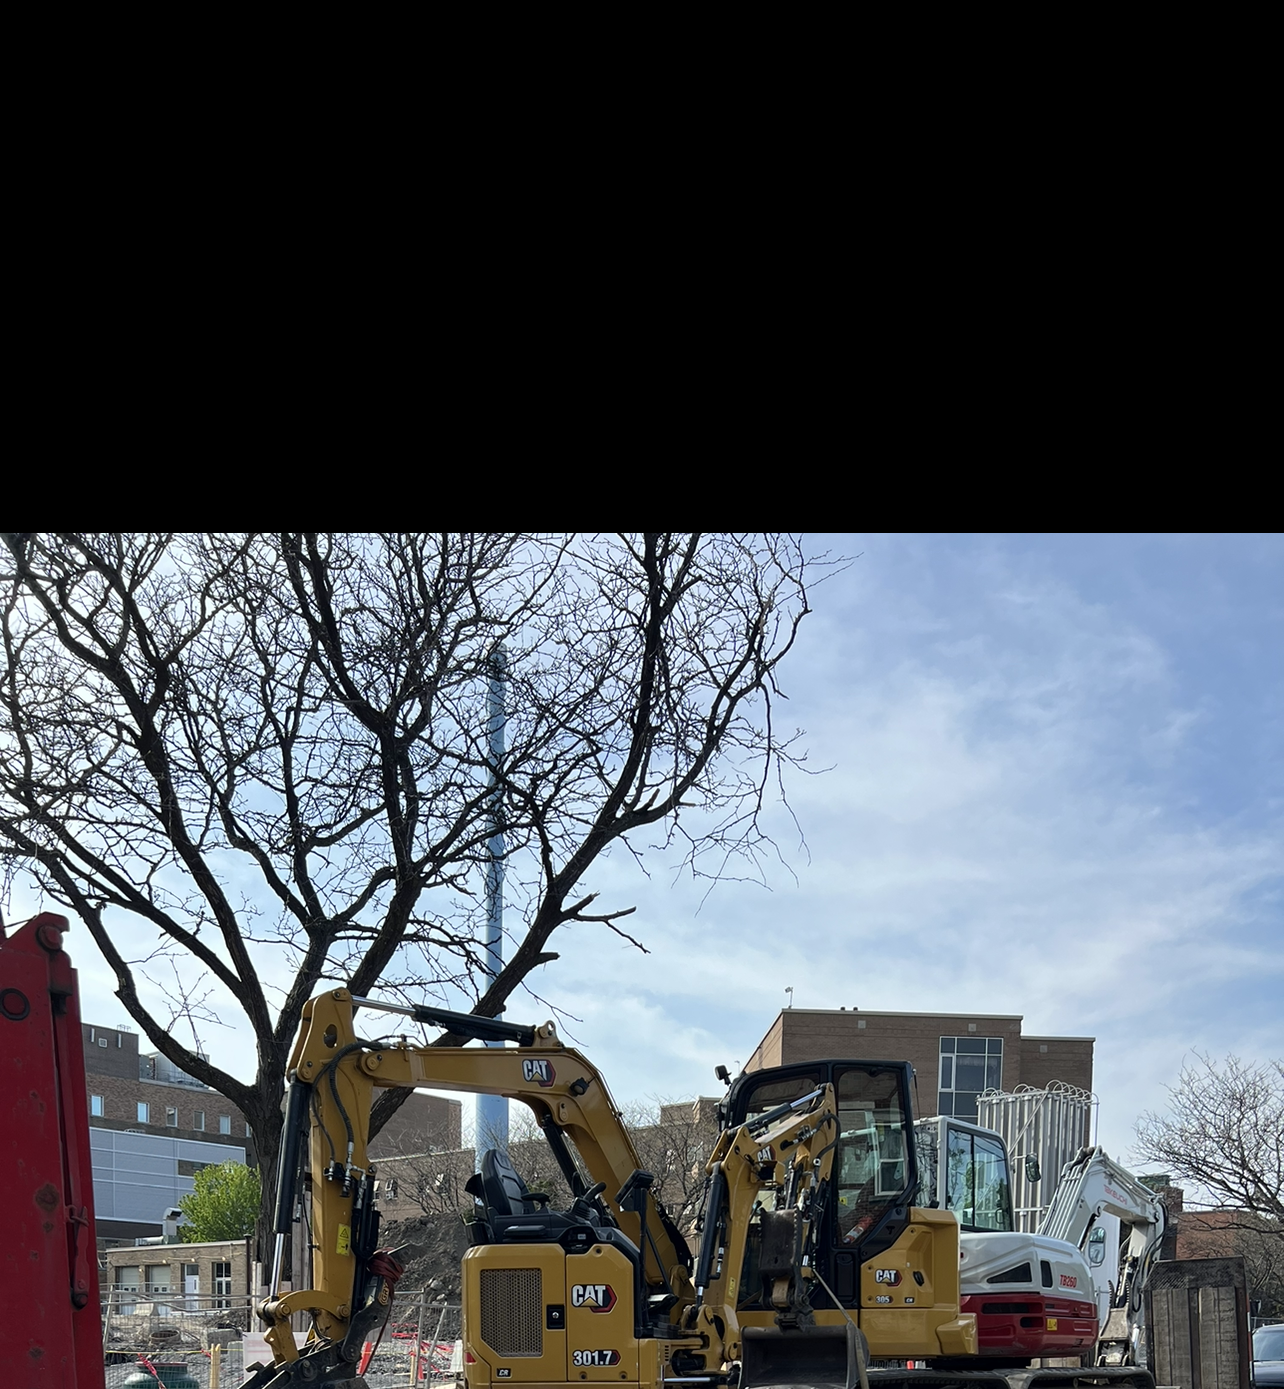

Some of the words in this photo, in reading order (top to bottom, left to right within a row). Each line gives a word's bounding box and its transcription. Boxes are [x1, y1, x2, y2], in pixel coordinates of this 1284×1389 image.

[523, 1060, 548, 1081] CAT
[757, 1145, 771, 1162] CAT
[876, 1269, 897, 1283] CAT
[1060, 1274, 1077, 1288] TB260
[572, 1285, 606, 1307] CAT
[876, 1295, 890, 1304] 305
[573, 1350, 613, 1366] 301.7
